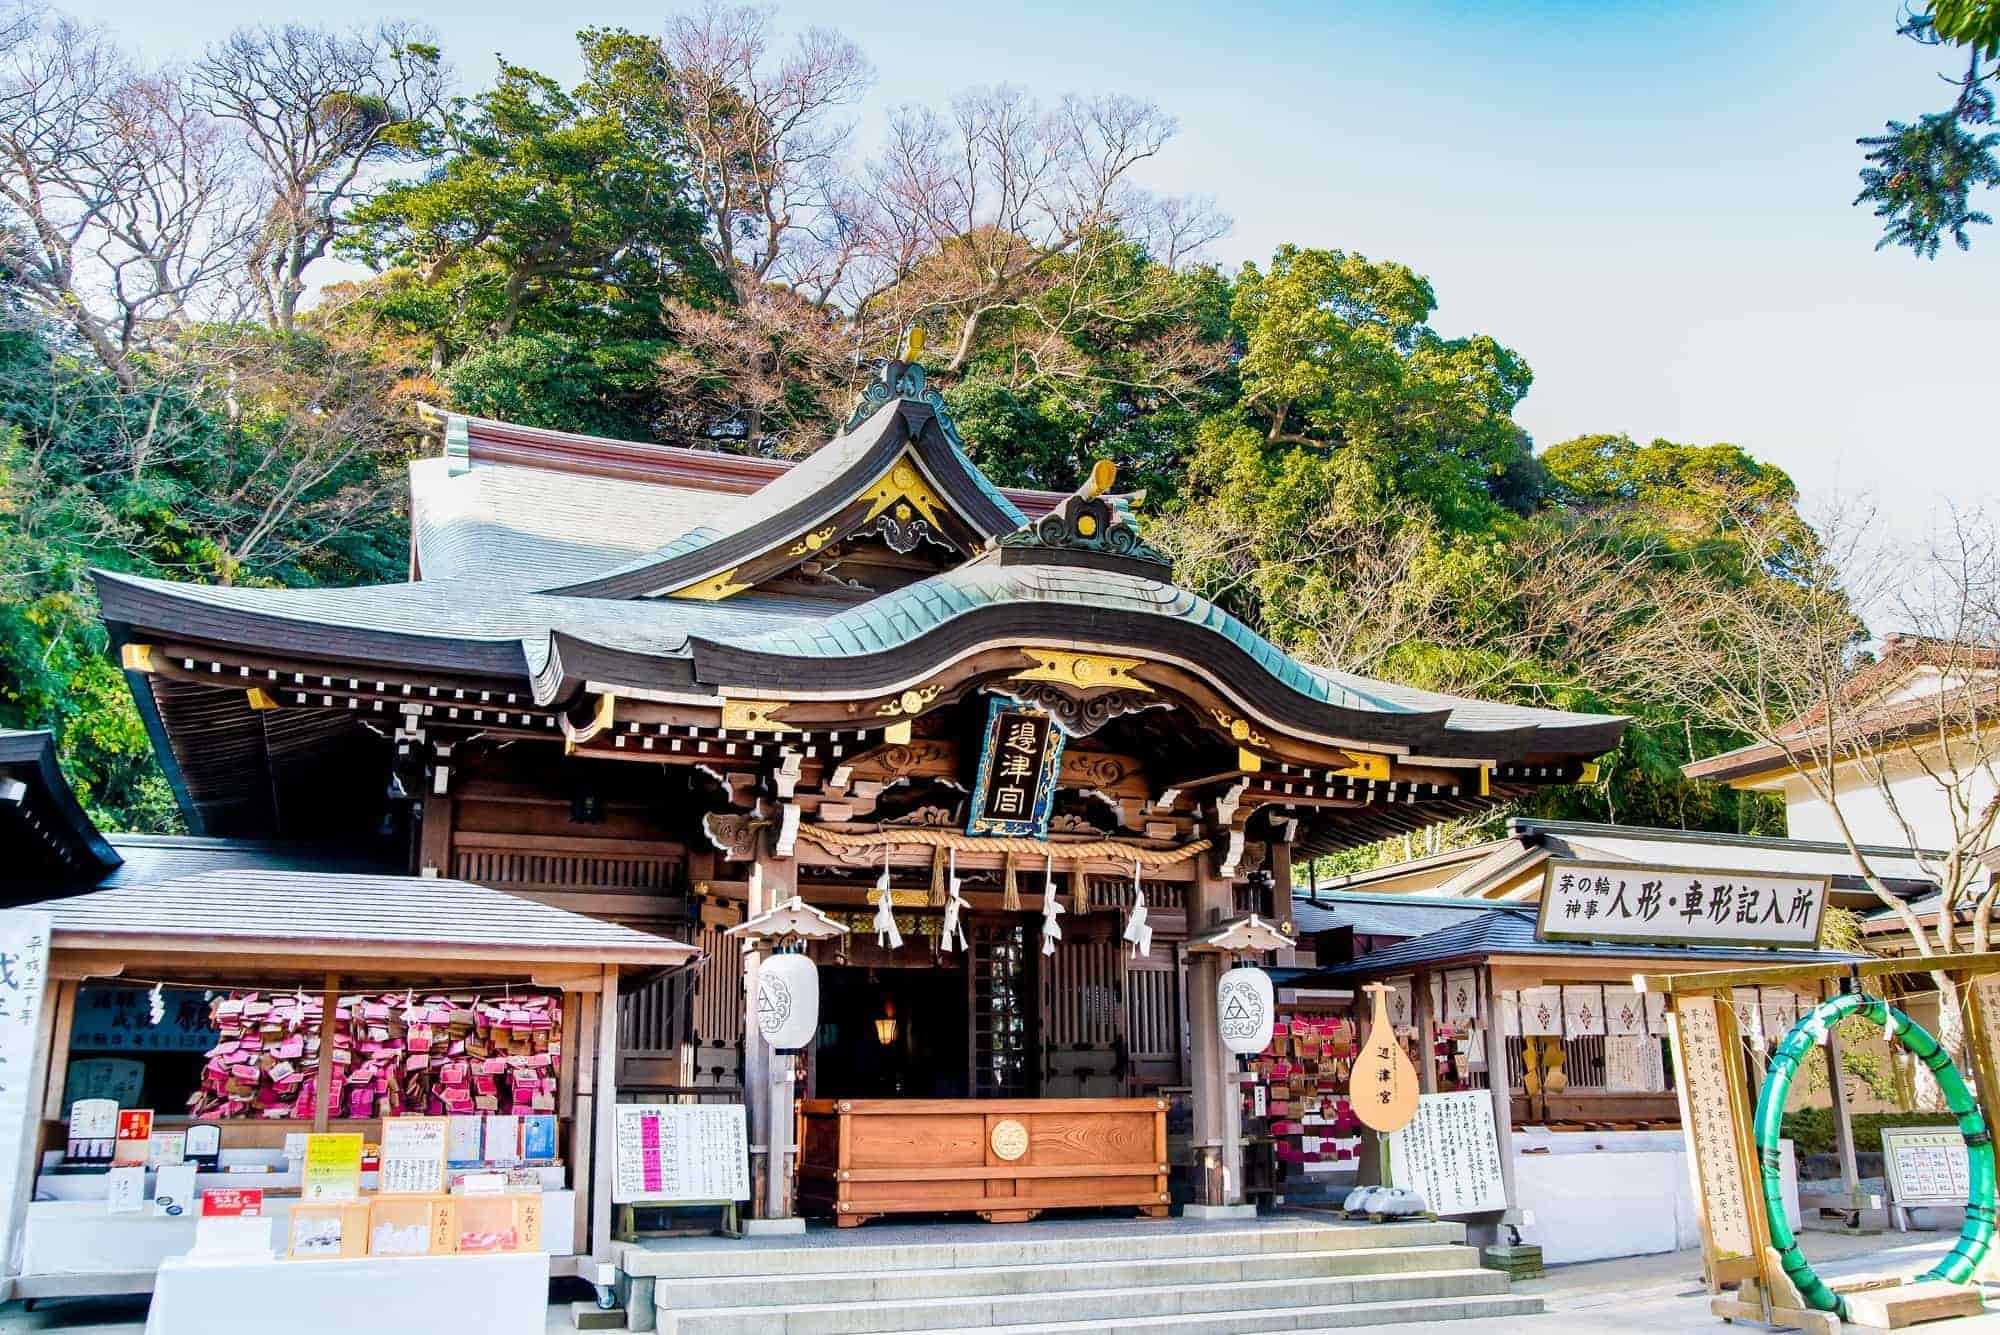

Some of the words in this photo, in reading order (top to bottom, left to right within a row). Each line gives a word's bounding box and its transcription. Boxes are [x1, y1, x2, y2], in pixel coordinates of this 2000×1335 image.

[1559, 875, 1611, 896] 茅の輪
[1564, 898, 1600, 920] 神事
[1605, 879, 1814, 929] 人形・車形記入所
